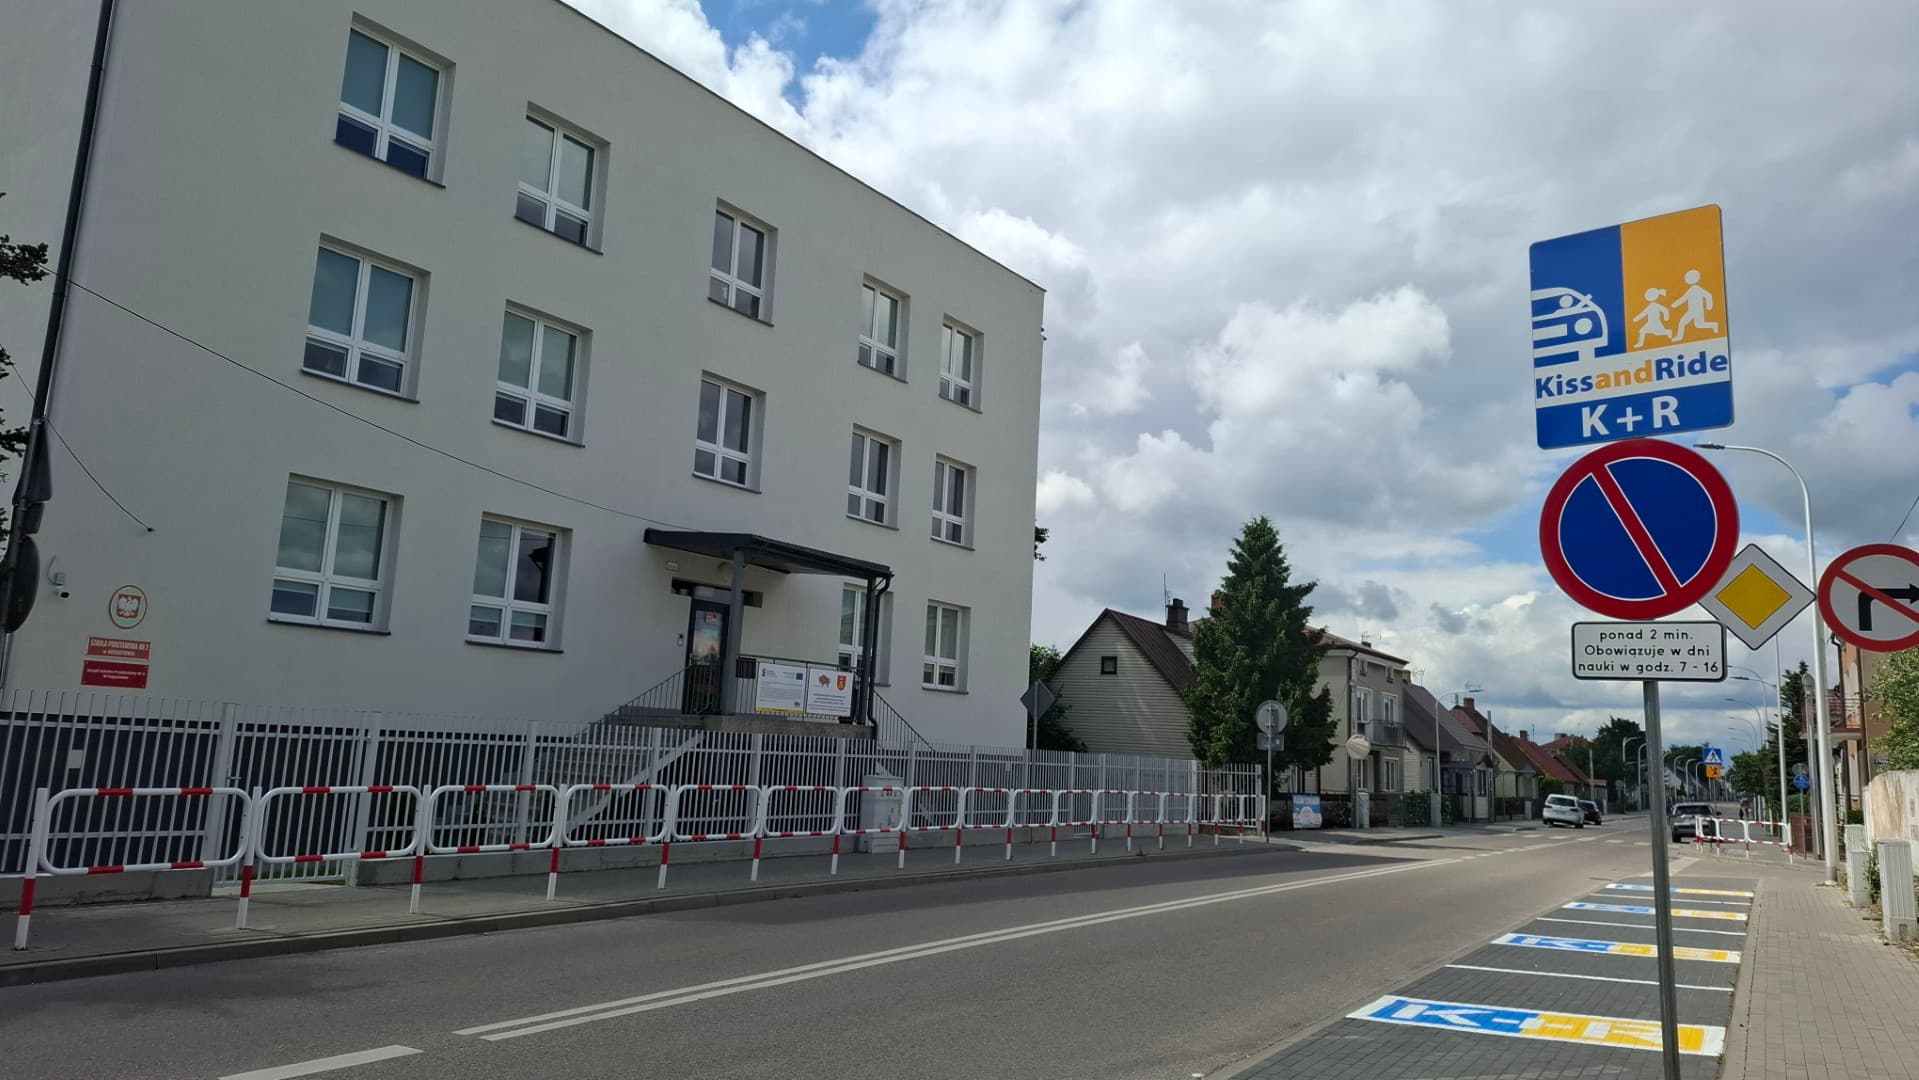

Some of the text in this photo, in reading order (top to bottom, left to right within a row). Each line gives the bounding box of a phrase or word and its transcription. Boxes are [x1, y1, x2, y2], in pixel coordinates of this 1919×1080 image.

[1535, 351, 1729, 399] KissandRide
[1600, 629, 1693, 642] ponad 2 min.
[1584, 644, 1710, 658] Obowiązuje w dni
[1578, 661, 1614, 671] nauki
[1636, 662, 1674, 674] godz.
[1680, 662, 1687, 672] 7
[1704, 662, 1719, 672] 16
